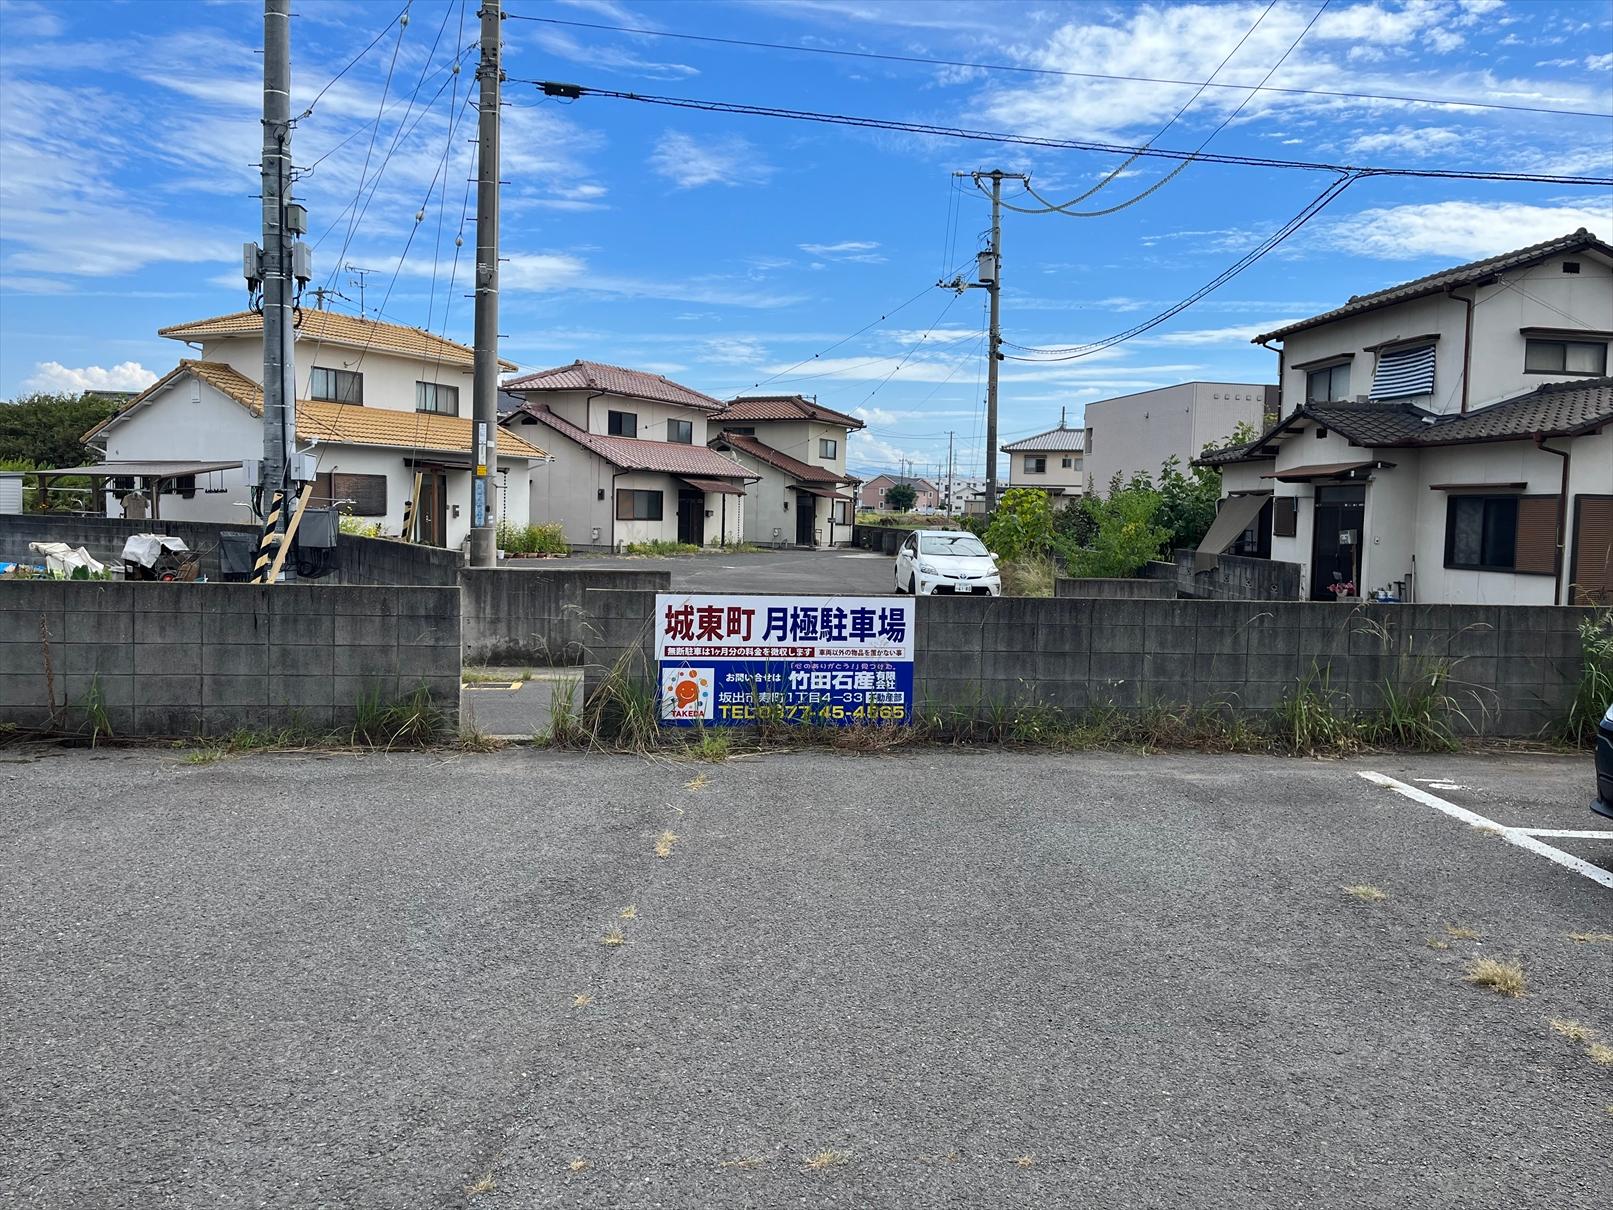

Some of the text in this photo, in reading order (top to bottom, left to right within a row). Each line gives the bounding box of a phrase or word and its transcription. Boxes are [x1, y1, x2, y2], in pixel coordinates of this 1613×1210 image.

[665, 605, 906, 643] 城東町 月極駐車場
[725, 673, 782, 683] お問い合せは
[788, 670, 875, 690] 竹田石産
[671, 710, 705, 718] TAKEDA
